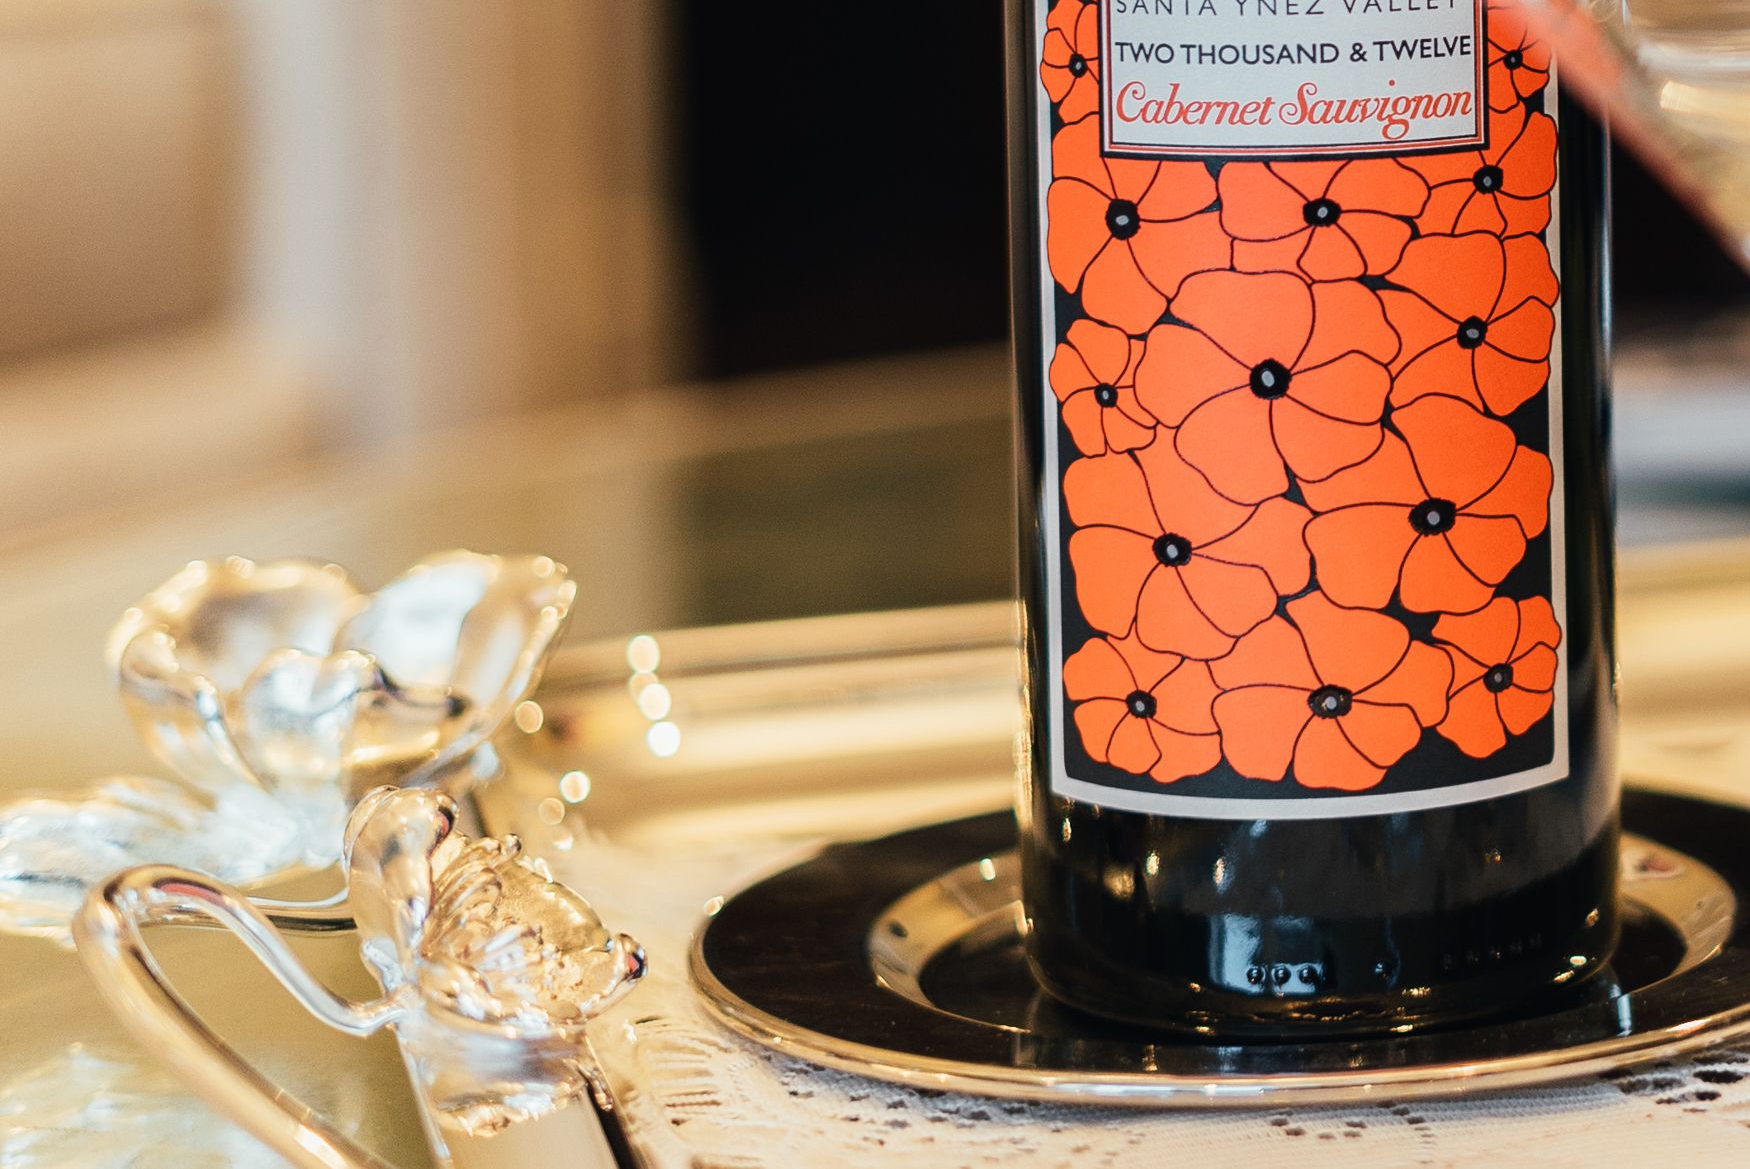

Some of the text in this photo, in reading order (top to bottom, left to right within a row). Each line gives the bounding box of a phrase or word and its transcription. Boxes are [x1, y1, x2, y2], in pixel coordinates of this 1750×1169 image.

[1115, 35, 1472, 65] TWO THOUSAND & TWELVE
[1115, 79, 1473, 140] Cabernet Sauvignon
